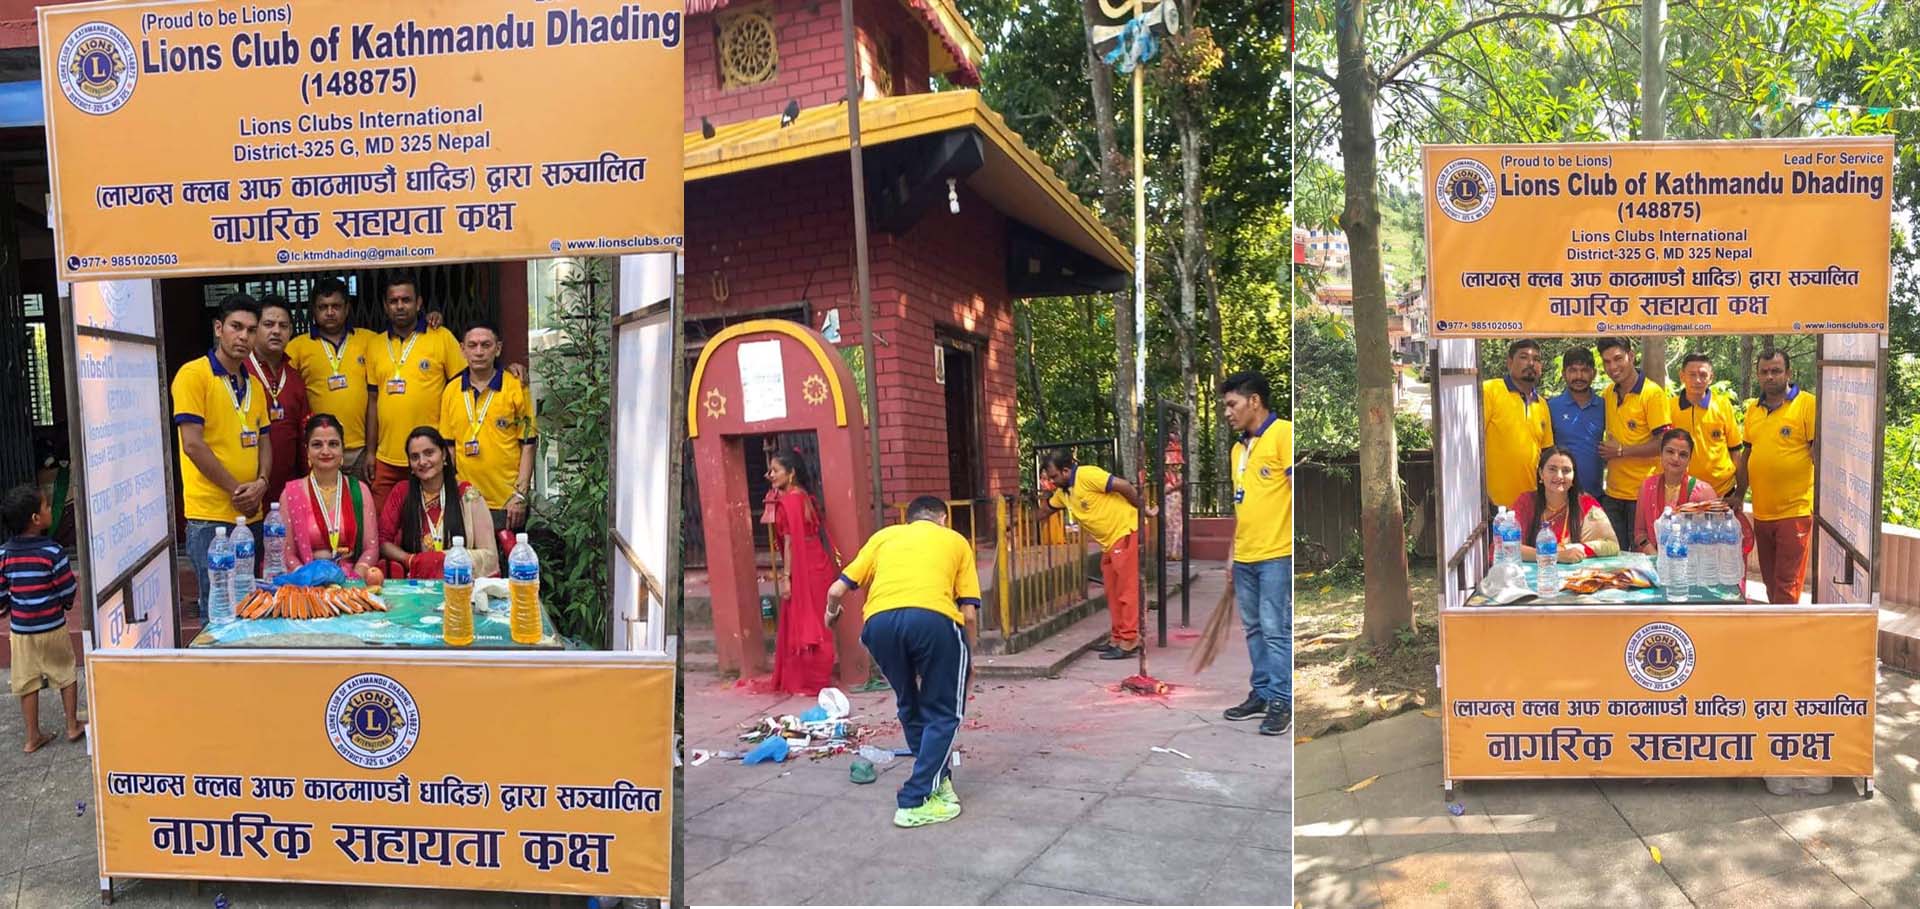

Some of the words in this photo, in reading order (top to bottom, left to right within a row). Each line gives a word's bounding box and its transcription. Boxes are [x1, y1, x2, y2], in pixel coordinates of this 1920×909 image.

[141, 11, 194, 35] (Proud
[196, 12, 211, 27] to
[216, 10, 237, 26] be
[242, 5, 292, 24] Lions)
[142, 39, 223, 74] Lions
[232, 30, 300, 69] Club
[310, 26, 340, 63] of
[352, 13, 534, 60] Kathmandu
[547, 5, 681, 48] Dhading
[301, 66, 417, 104] (148875)
[240, 118, 292, 136] Lions
[298, 113, 353, 133] Clubs
[359, 104, 482, 129] International
[234, 139, 335, 162] District-325
[340, 138, 359, 157] G,
[365, 136, 394, 154] MD
[400, 134, 432, 153] 325
[438, 131, 490, 153] Nepal
[1501, 154, 1541, 168] (Proud
[1544, 155, 1554, 167] to
[1558, 157, 1571, 166] be
[1577, 156, 1611, 167] Lions)
[1784, 154, 1813, 165] Lead
[1817, 154, 1835, 164] For
[1840, 153, 1883, 164] Service
[96, 183, 174, 208] (लायन्स
[182, 180, 231, 204] क्लब
[239, 178, 282, 201] अफ
[1502, 173, 1559, 196] Lions
[1568, 172, 1616, 196] Club
[1626, 172, 1646, 196] of
[1656, 172, 1783, 195] Kathmandu
[1792, 170, 1883, 200] Dhading
[211, 207, 320, 243] नागरिक
[333, 206, 446, 238] सहायता
[456, 202, 516, 232] कक्ष
[1617, 201, 1701, 222] (148875)
[567, 236, 684, 249] www.lionsclubs.org
[1572, 231, 1610, 241] Lions
[1615, 231, 1655, 241] Clubs
[1660, 230, 1746, 241] International
[81, 257, 108, 268] 977+
[111, 254, 178, 267] 9851020503
[1568, 248, 1641, 260] District-325
[1645, 248, 1660, 260] G,
[1664, 248, 1685, 259] MD
[1690, 248, 1711, 259] 325
[1716, 248, 1751, 260] Nepal
[1463, 272, 1519, 288] (लायन्स
[1529, 272, 1562, 288] क्लब
[1572, 272, 1600, 288] अफ
[1550, 292, 1628, 316] नागरिक
[1641, 295, 1718, 316] सहायता
[1729, 296, 1768, 315] कक्ष
[1448, 321, 1468, 329] 977+
[1472, 322, 1521, 330] 9851020503
[1806, 322, 1884, 330] www.lionsclubs.org
[353, 691, 392, 707] LIONS
[1454, 700, 1515, 717] (लायन्स
[1523, 700, 1560, 716] क्लब
[1567, 700, 1601, 716] अफ
[328, 713, 337, 735] LIONS
[366, 709, 382, 731] L
[1488, 728, 1612, 761] नागरिक
[1630, 733, 1754, 761] सहायता
[1769, 733, 1833, 761] कक्ष
[107, 772, 186, 797] (लायन्स
[193, 775, 243, 798] क्लब
[250, 777, 296, 799] अफ
[149, 812, 313, 860] नागरिक
[331, 824, 506, 868] सहायता
[519, 831, 615, 873] कक्ष
